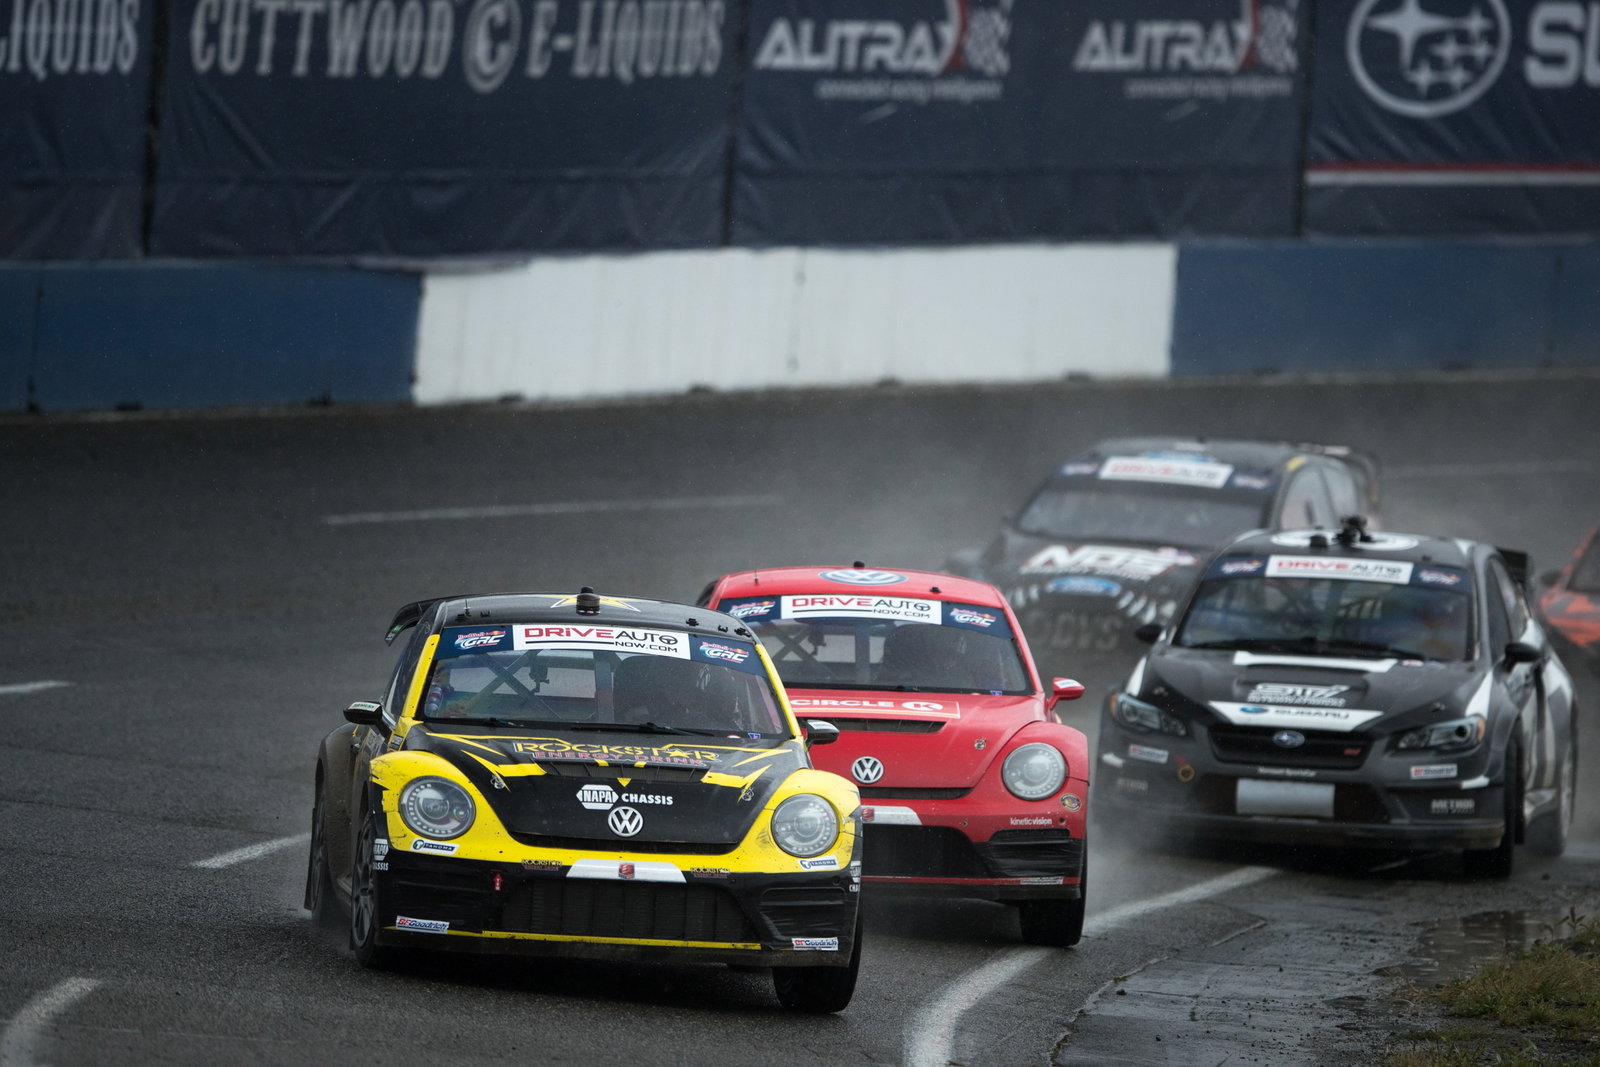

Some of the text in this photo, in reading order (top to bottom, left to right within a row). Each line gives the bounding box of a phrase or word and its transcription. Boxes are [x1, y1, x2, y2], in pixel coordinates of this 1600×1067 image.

[190, 0, 455, 77] CUTTWOOD
[872, 609, 930, 618] NOW.COM
[615, 641, 678, 653] NOW.COM
[790, 699, 895, 708] CIRCLE
[533, 751, 707, 767] ENERGY DRINK
[583, 790, 674, 805] NAPA CHASSIS
